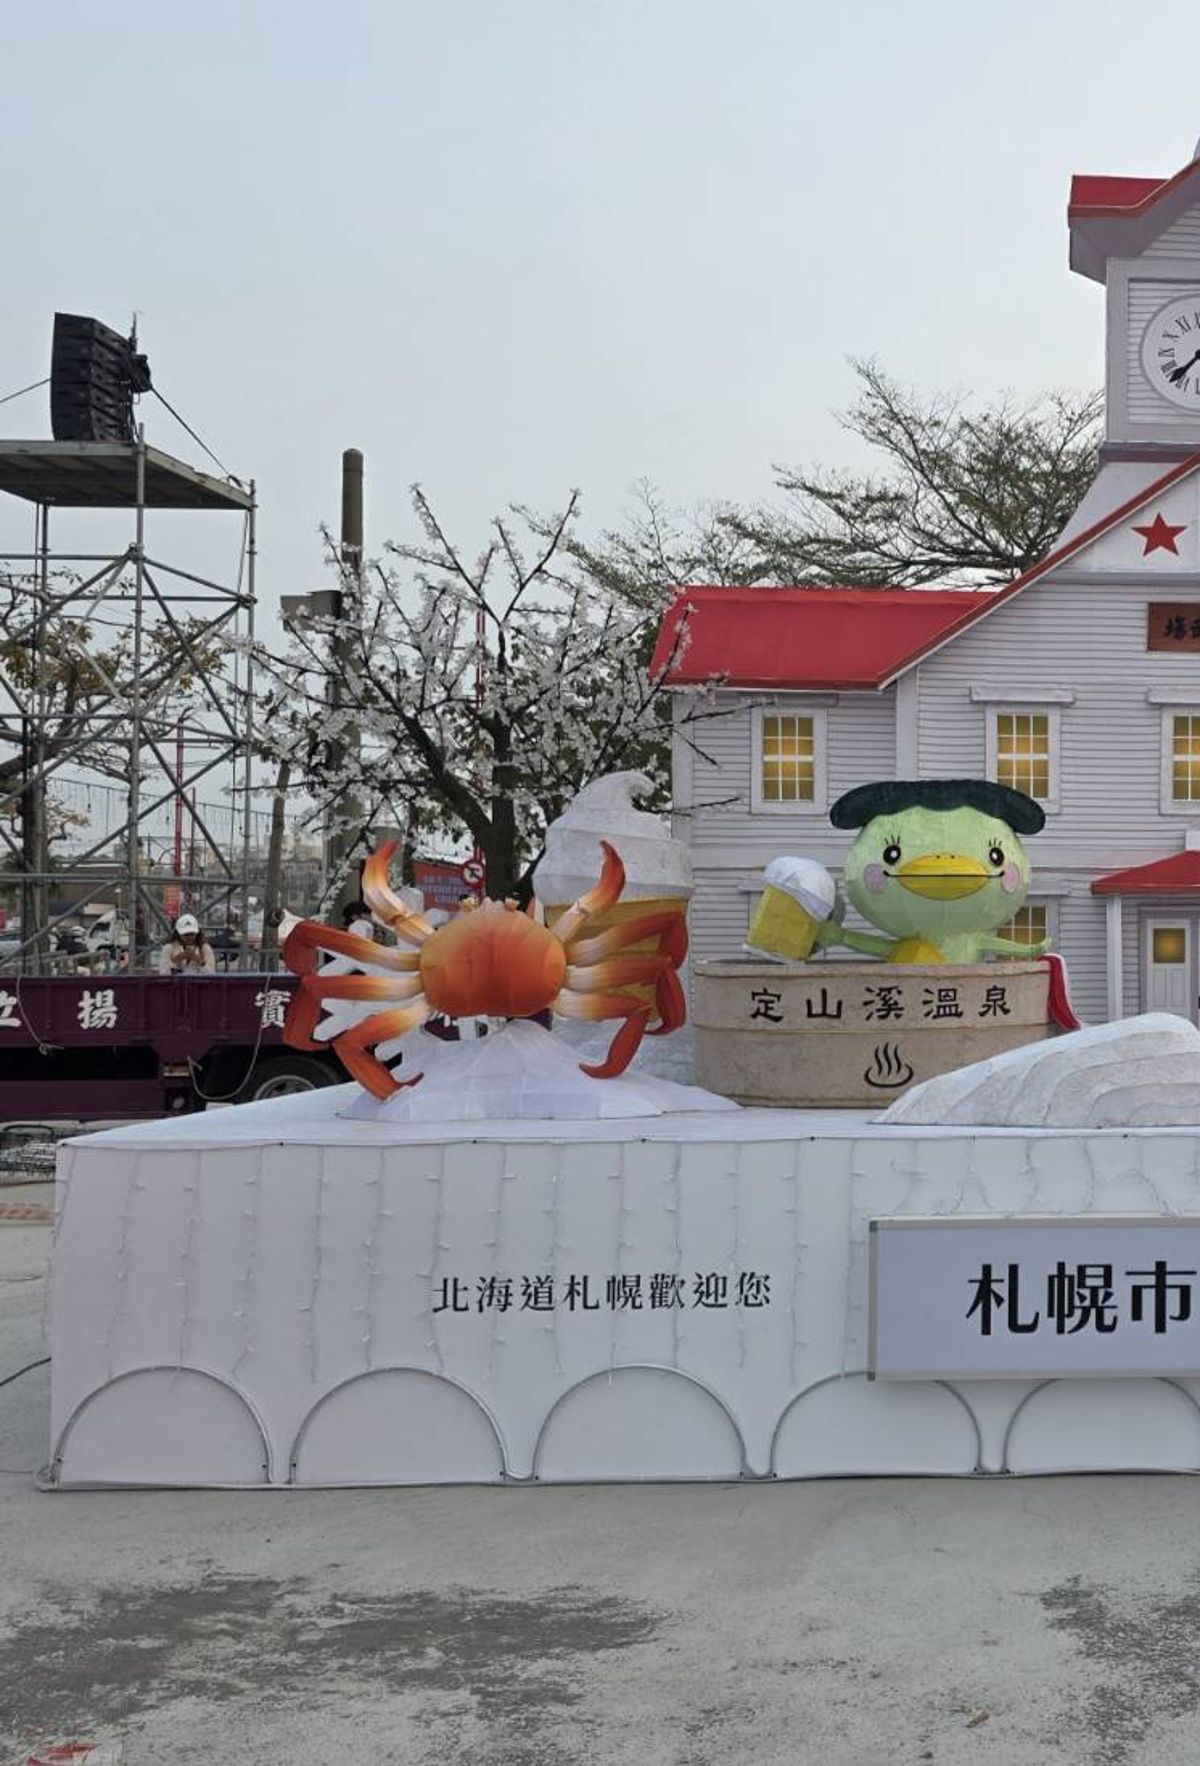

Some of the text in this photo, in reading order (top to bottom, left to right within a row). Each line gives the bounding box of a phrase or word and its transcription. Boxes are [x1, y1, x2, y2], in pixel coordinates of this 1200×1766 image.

[749, 984, 1012, 1023] 定山溪溫泉
[432, 1271, 771, 1314] 北海道札幌歡迎您
[965, 1260, 1198, 1336] 札幌市
